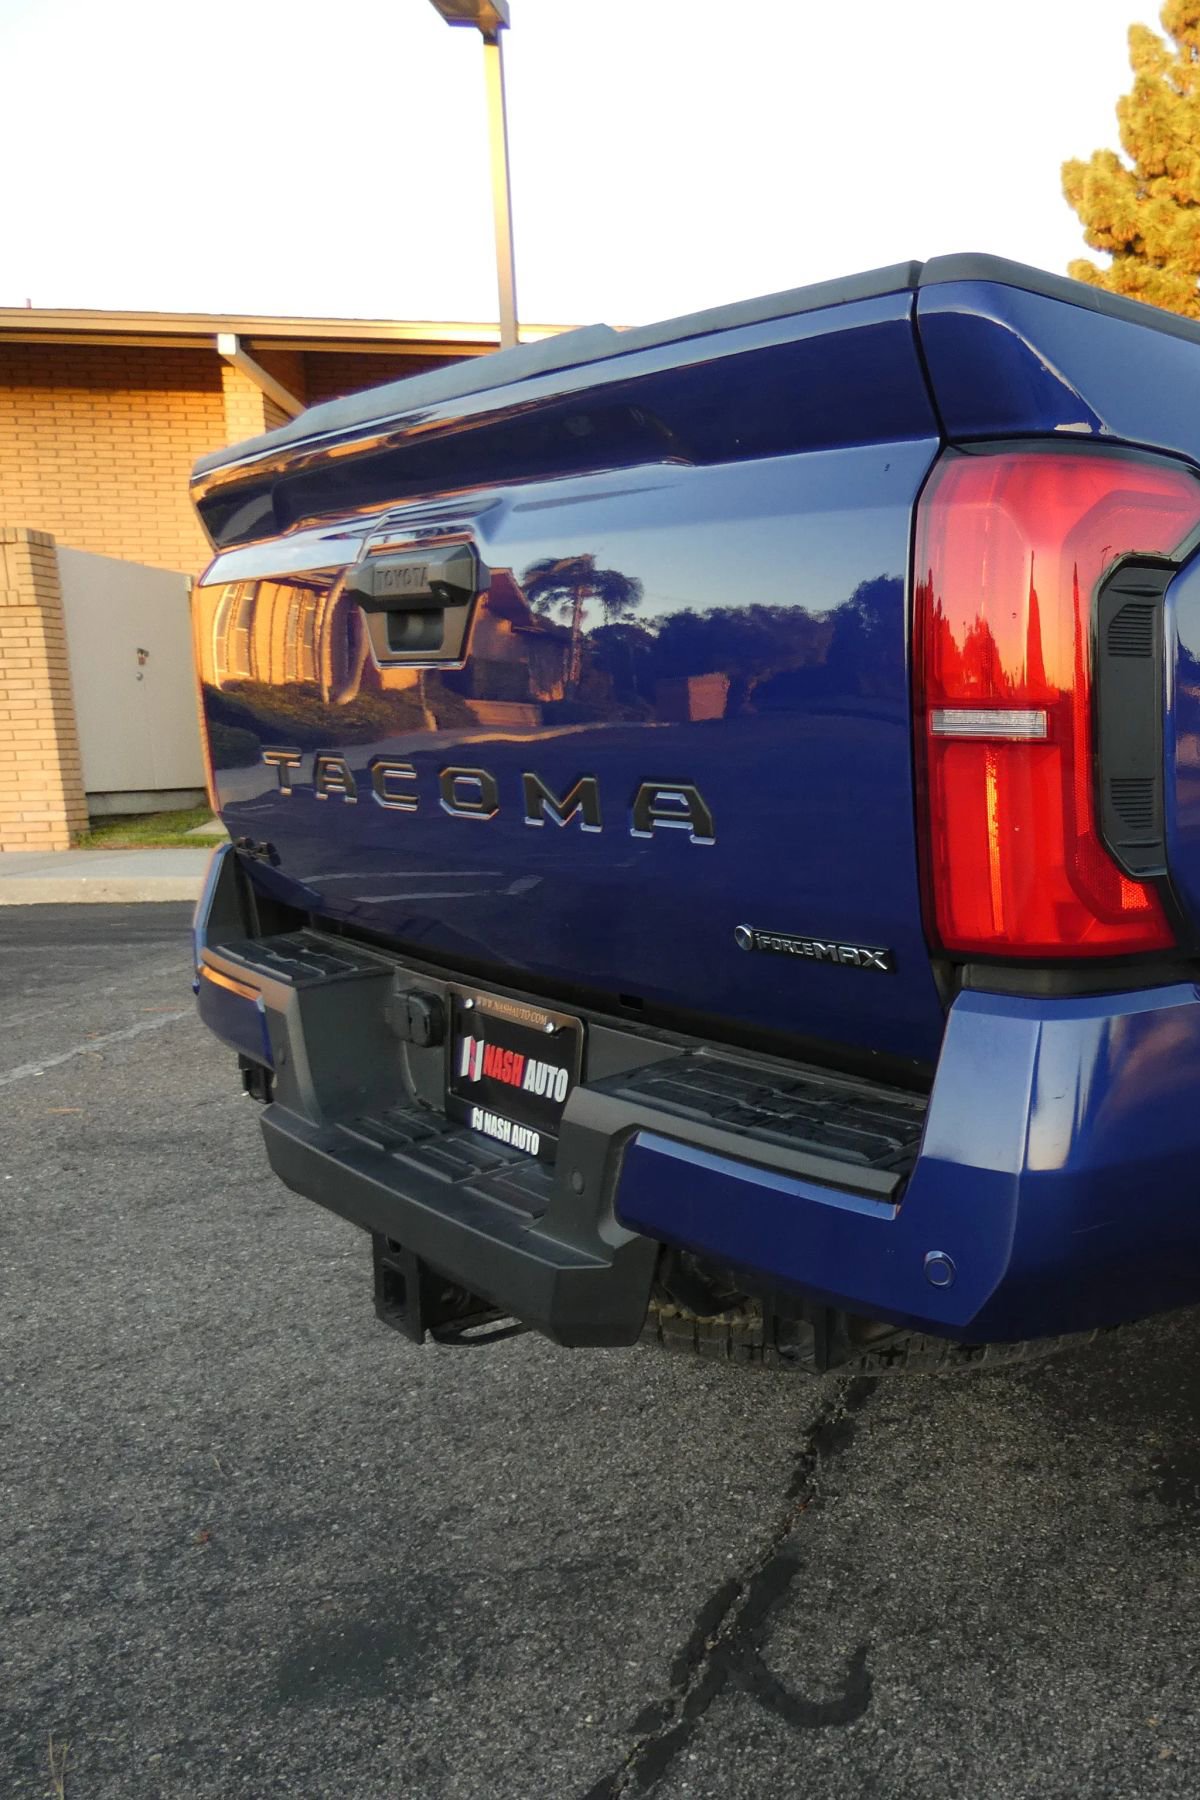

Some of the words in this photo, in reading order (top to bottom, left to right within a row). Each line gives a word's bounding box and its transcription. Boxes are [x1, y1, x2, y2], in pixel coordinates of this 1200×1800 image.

[261, 745, 717, 845] TACOMA
[483, 1043, 525, 1087] NASH
[523, 1059, 568, 1103] AUTO
[484, 1112, 512, 1143] NASH
[511, 1125, 540, 1156] AUTO
